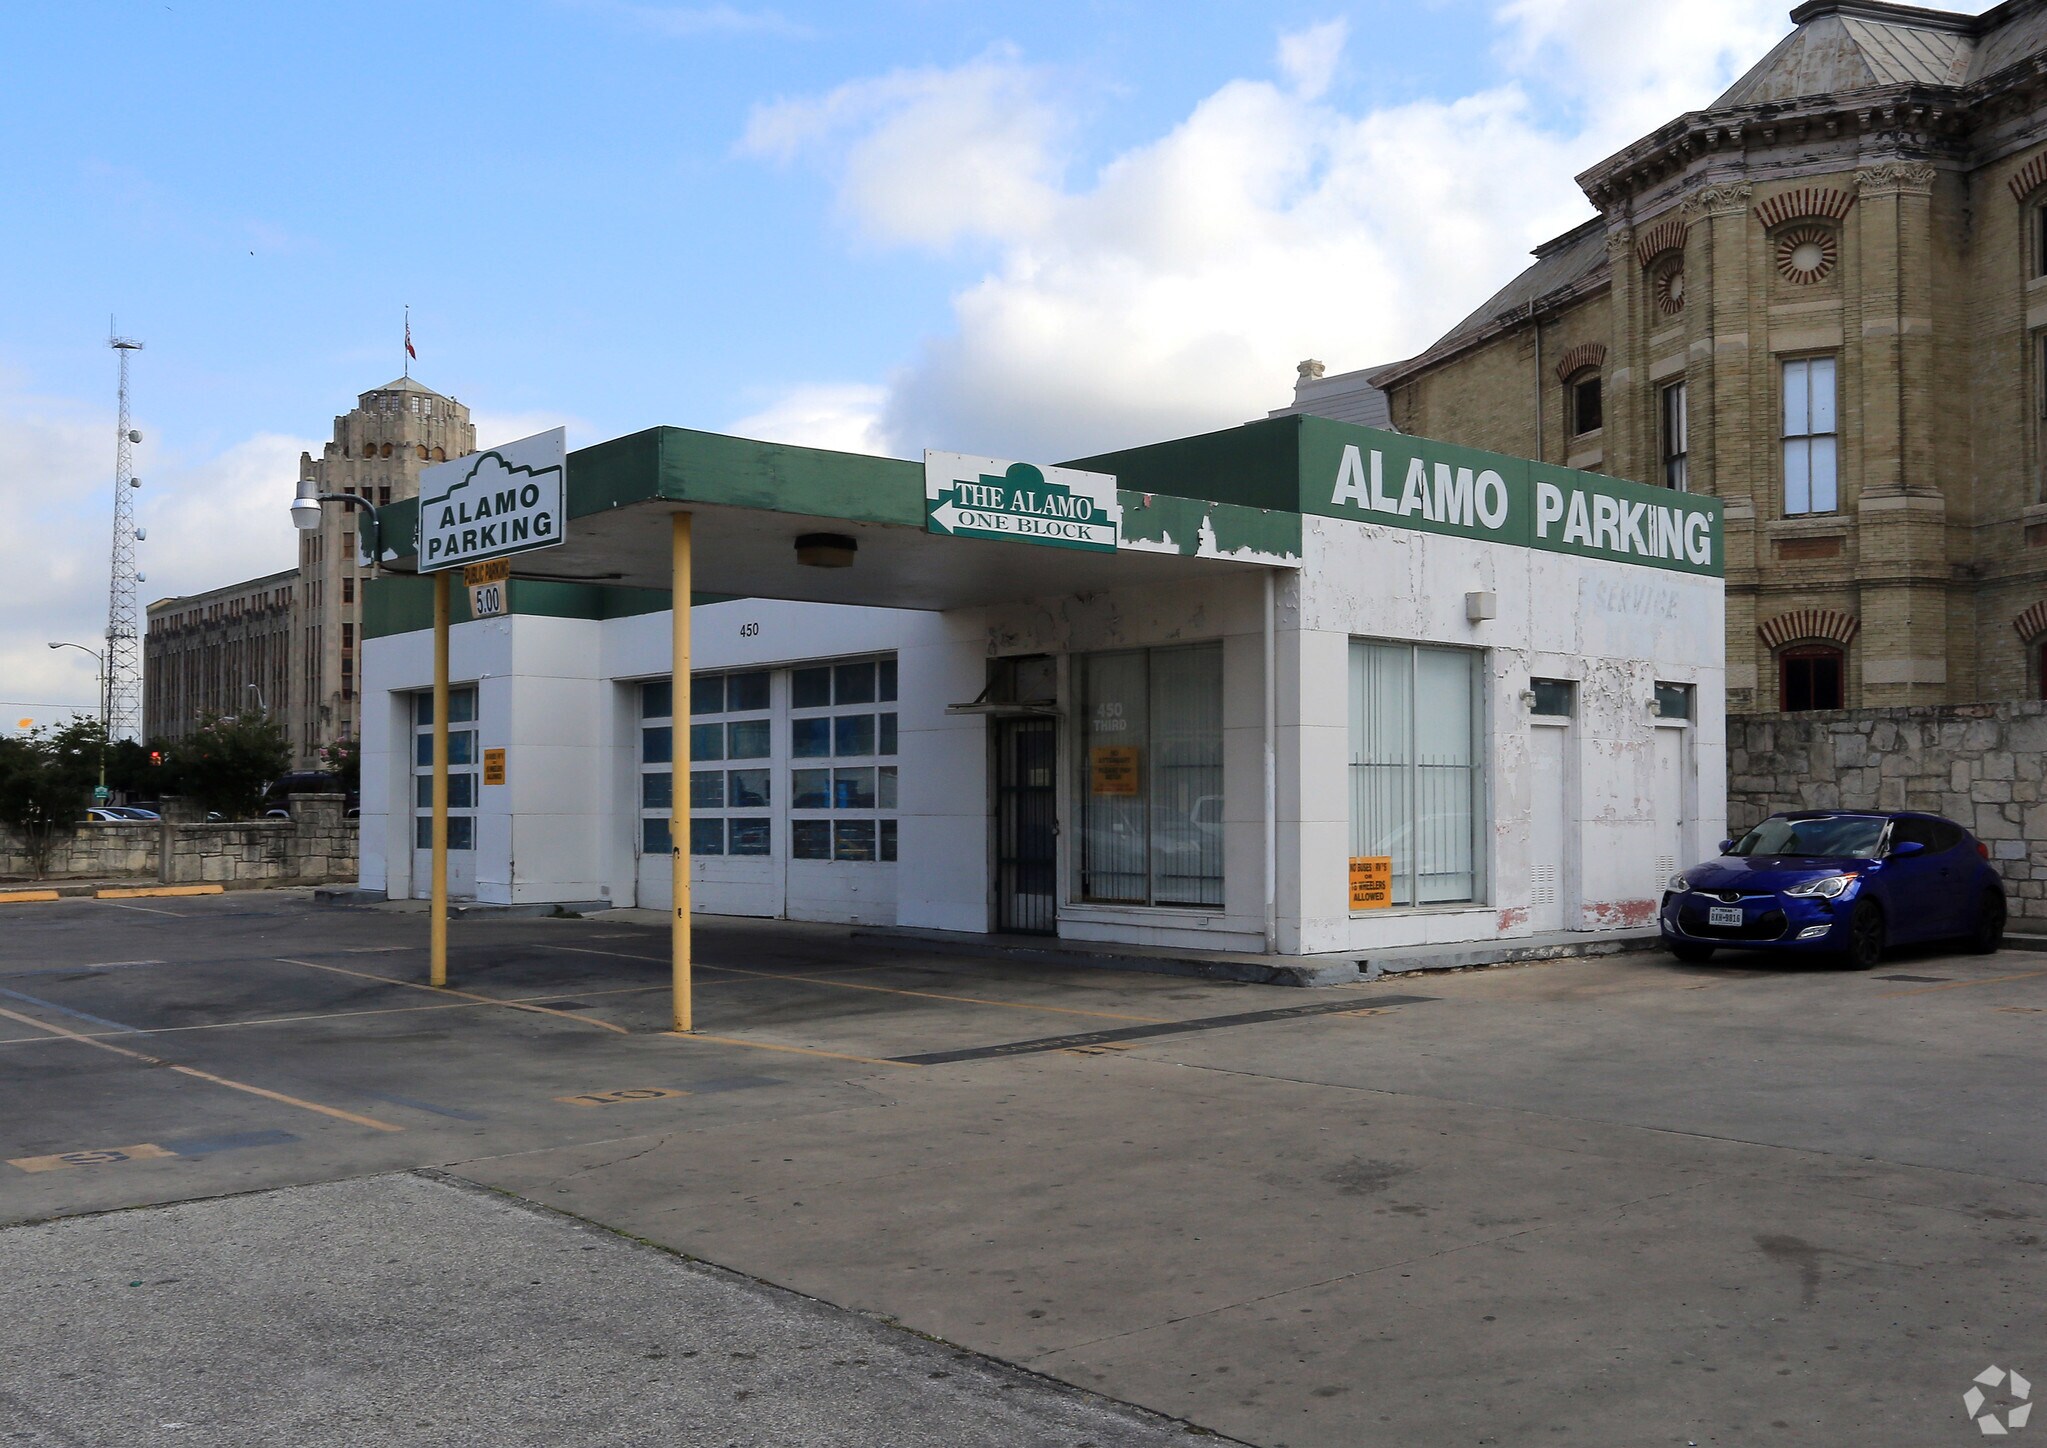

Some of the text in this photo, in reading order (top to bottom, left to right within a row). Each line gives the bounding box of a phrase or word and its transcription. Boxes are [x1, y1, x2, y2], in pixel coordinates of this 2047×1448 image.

[1331, 444, 1508, 530] ALAMO
[439, 484, 540, 529] ALAMO
[955, 482, 1092, 521] THE ALAMO
[958, 511, 1093, 540] ONE BLOCK
[429, 512, 551, 560] PARKING
[476, 587, 500, 614] 5.00
[740, 622, 759, 638] 450
[1097, 702, 1123, 717] 450
[1093, 719, 1127, 732] THIRD
[1357, 863, 1372, 872] BUSES
[1359, 880, 1385, 890] WHEELERS
[1354, 892, 1384, 901] ALLOWED
[576, 1089, 667, 1104] 10
